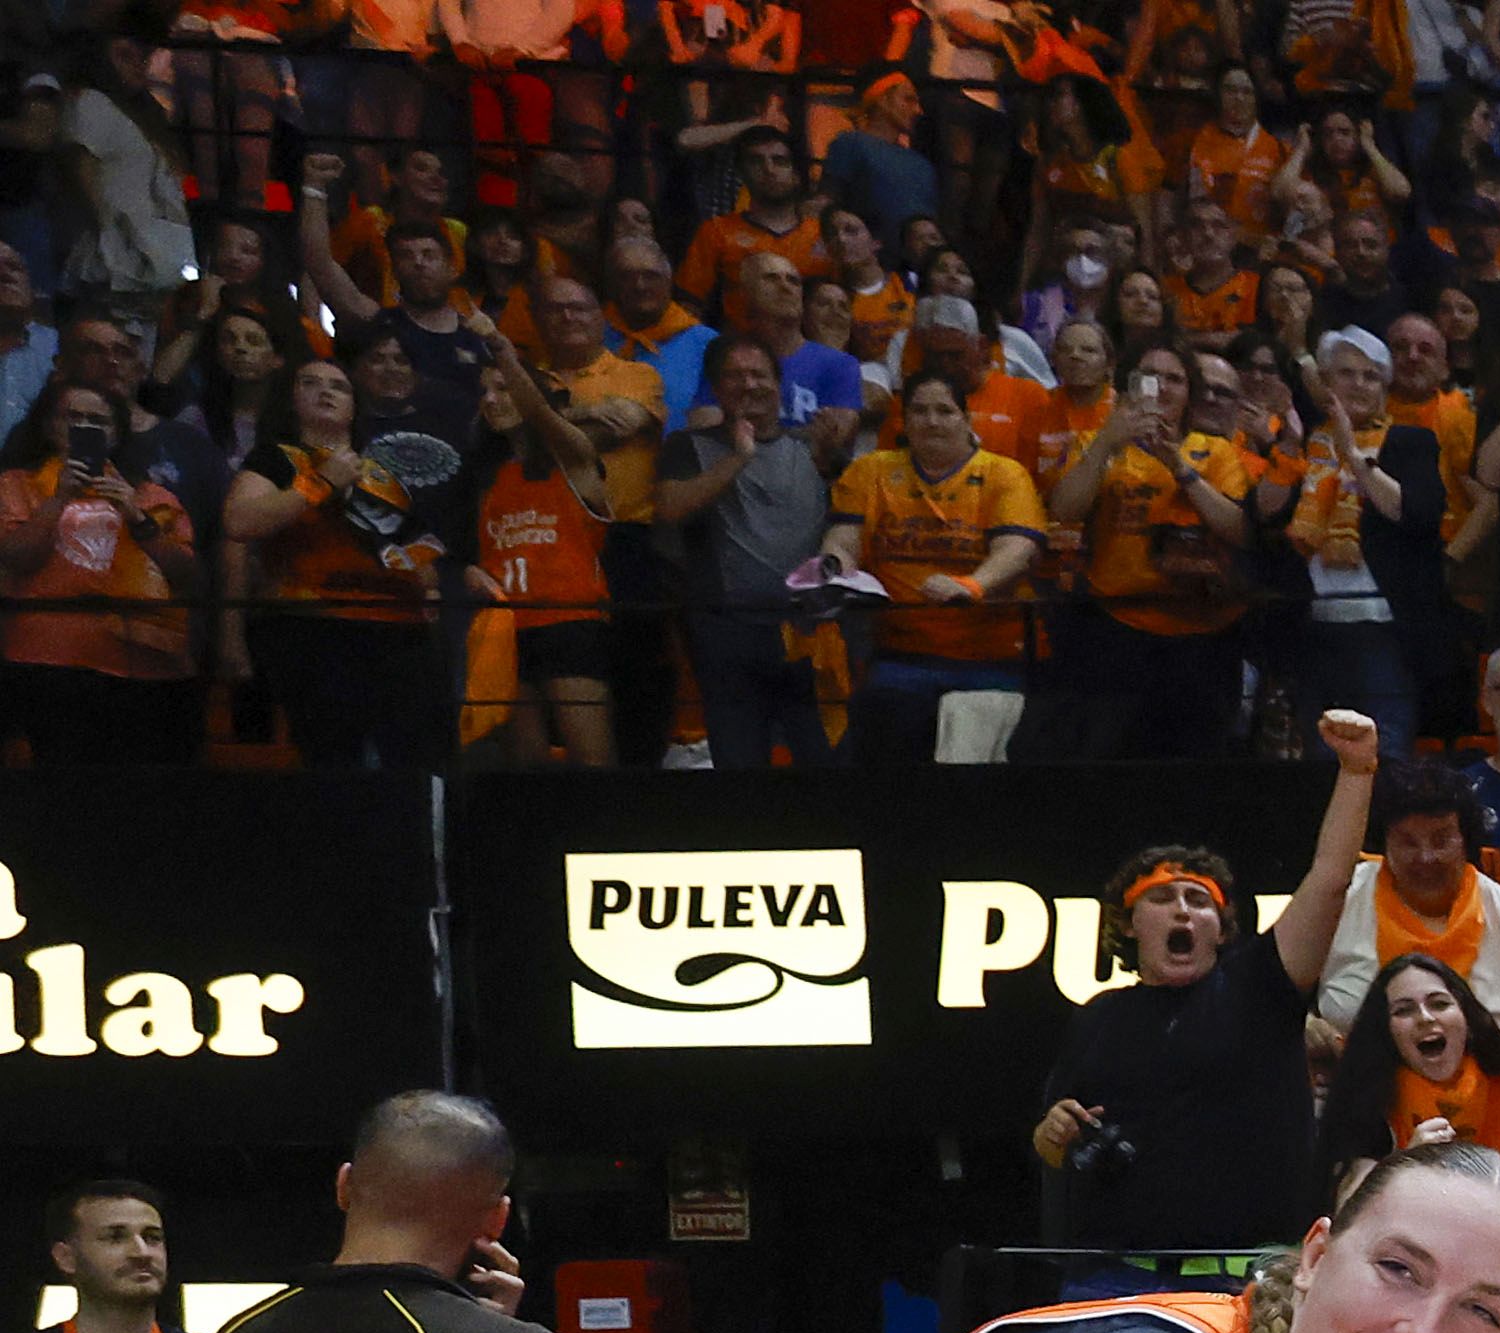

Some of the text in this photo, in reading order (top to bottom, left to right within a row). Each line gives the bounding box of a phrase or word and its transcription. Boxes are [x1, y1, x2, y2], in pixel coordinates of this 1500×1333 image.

[503, 557, 528, 593] 11
[588, 879, 846, 930] PULEVA
[0, 942, 304, 1058] lar
